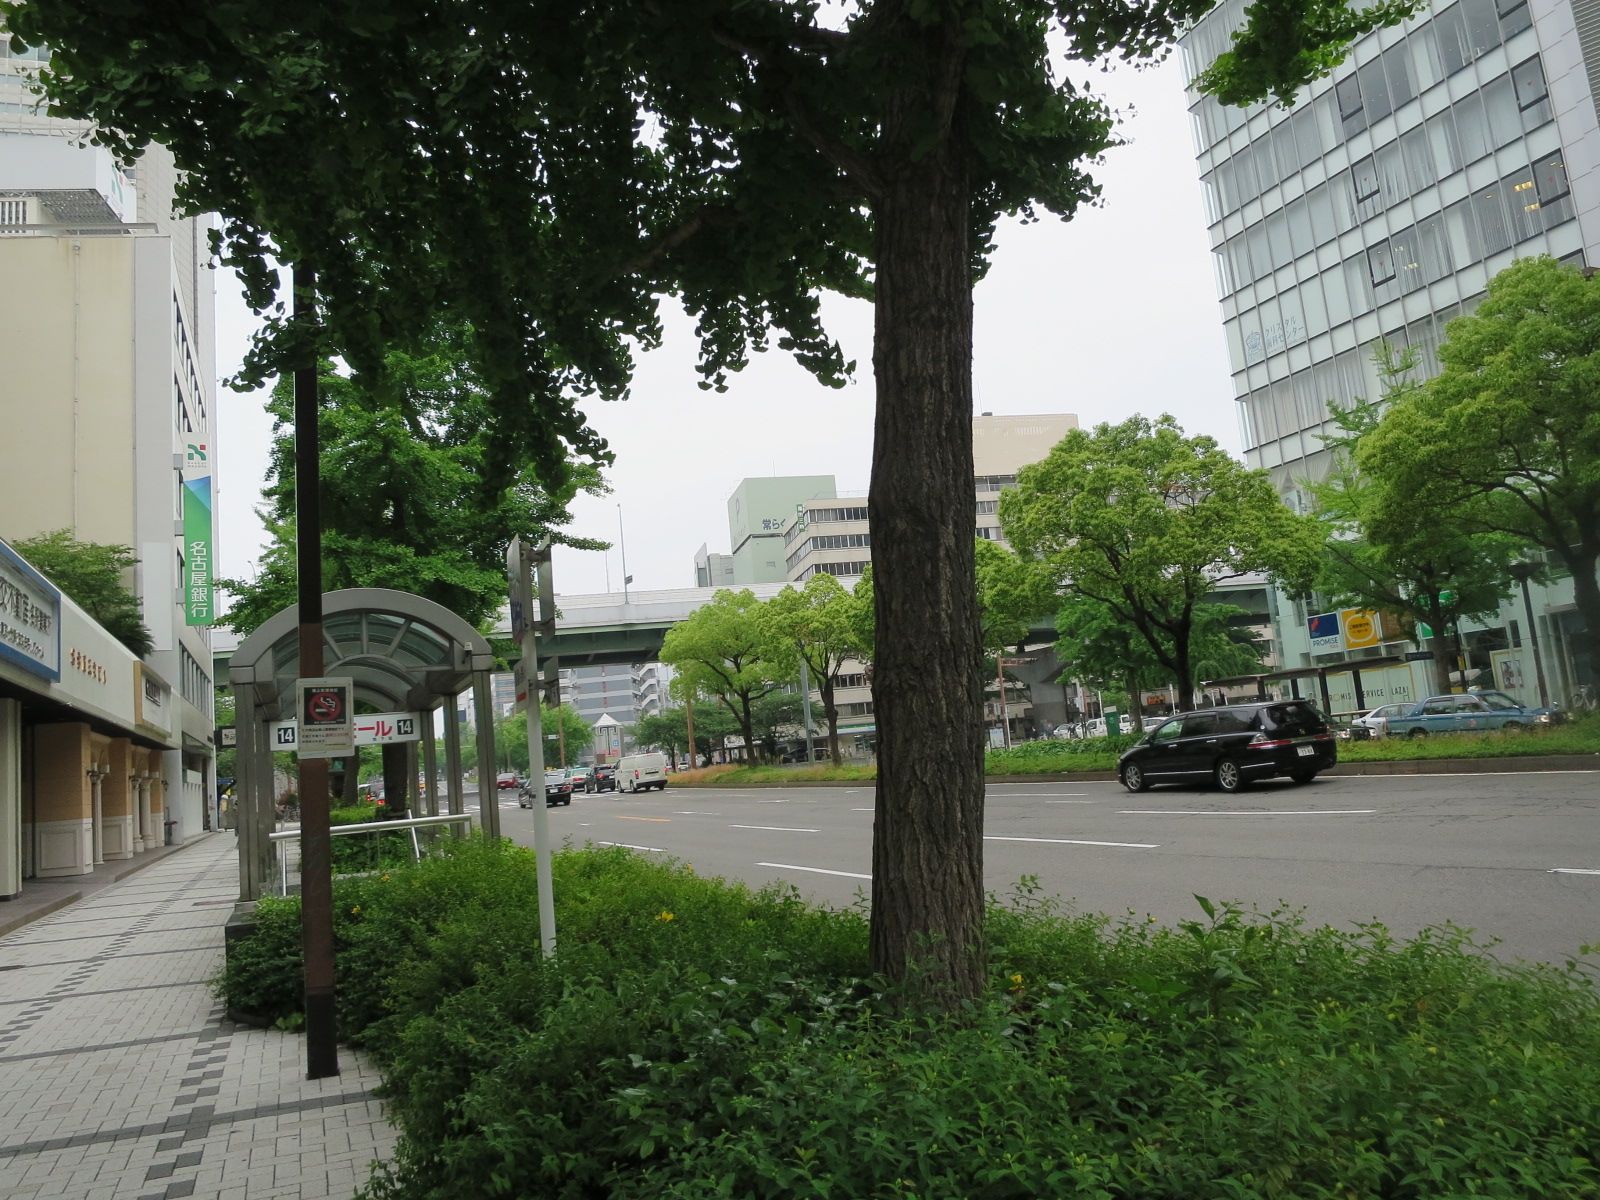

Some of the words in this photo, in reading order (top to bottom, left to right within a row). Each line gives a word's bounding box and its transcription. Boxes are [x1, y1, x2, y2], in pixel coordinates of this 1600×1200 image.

[189, 541, 208, 618] 名古屋銀行
[1312, 637, 1339, 647] PROMISE
[278, 728, 294, 743] 14
[353, 720, 392, 738] ール
[398, 720, 412, 734] 14
